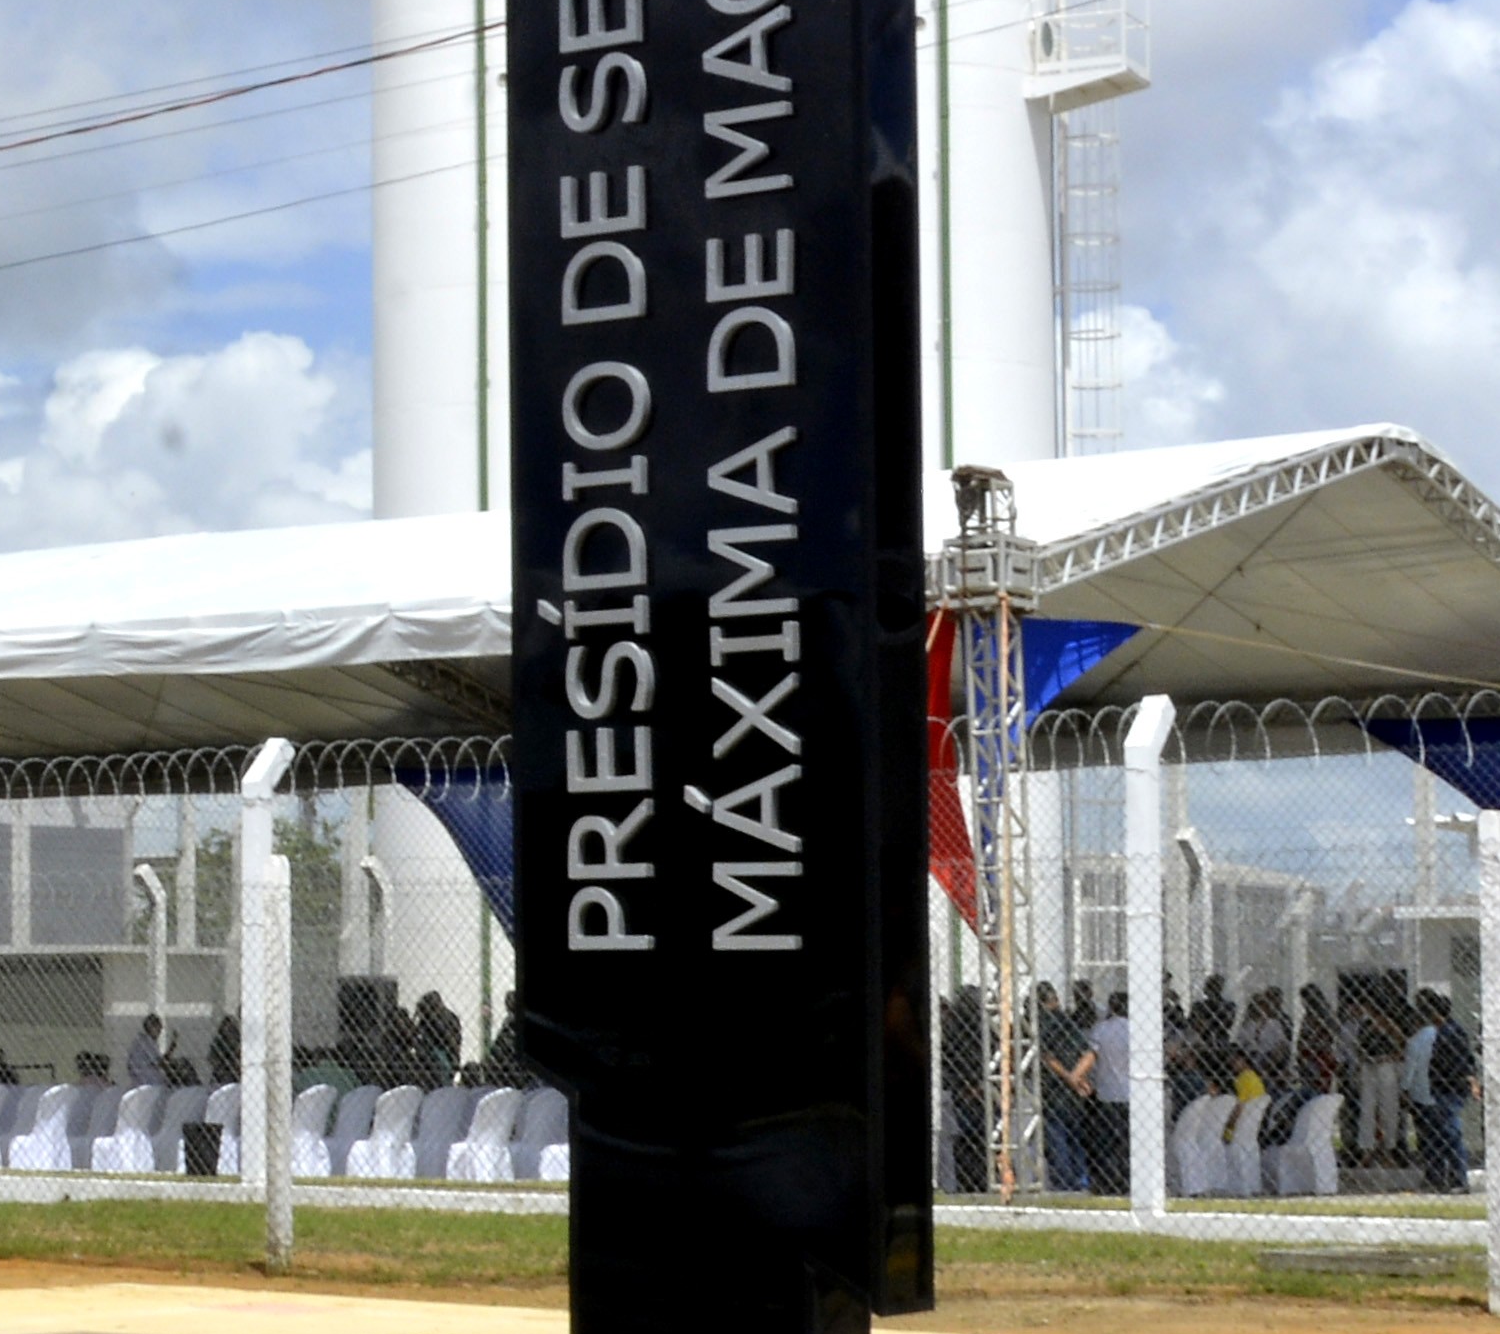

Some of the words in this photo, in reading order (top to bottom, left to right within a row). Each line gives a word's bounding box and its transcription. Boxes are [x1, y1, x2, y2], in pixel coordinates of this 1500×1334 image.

[560, 165, 647, 325] DE
[705, 228, 797, 394] DE
[538, 361, 656, 951] PRESÍDIO
[683, 426, 803, 951] MÁXIMA
